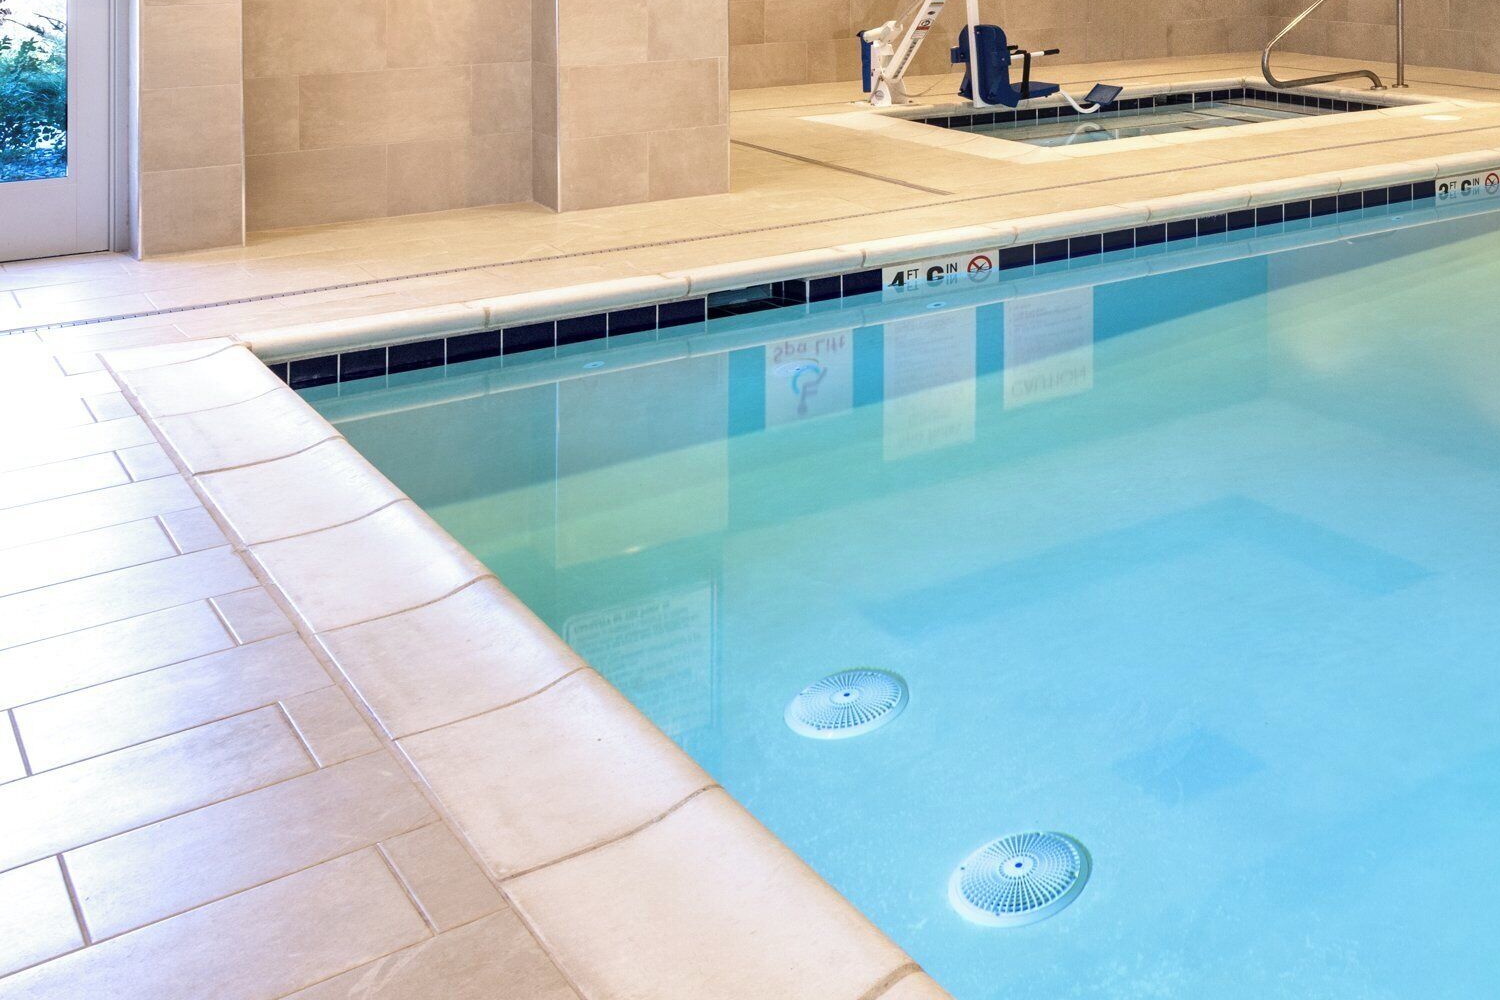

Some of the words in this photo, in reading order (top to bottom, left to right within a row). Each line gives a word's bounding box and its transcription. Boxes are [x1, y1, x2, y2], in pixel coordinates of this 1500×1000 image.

[1450, 181, 1457, 190] FT
[1473, 178, 1480, 186] IN
[907, 269, 919, 280] FT
[947, 262, 957, 273] IN
